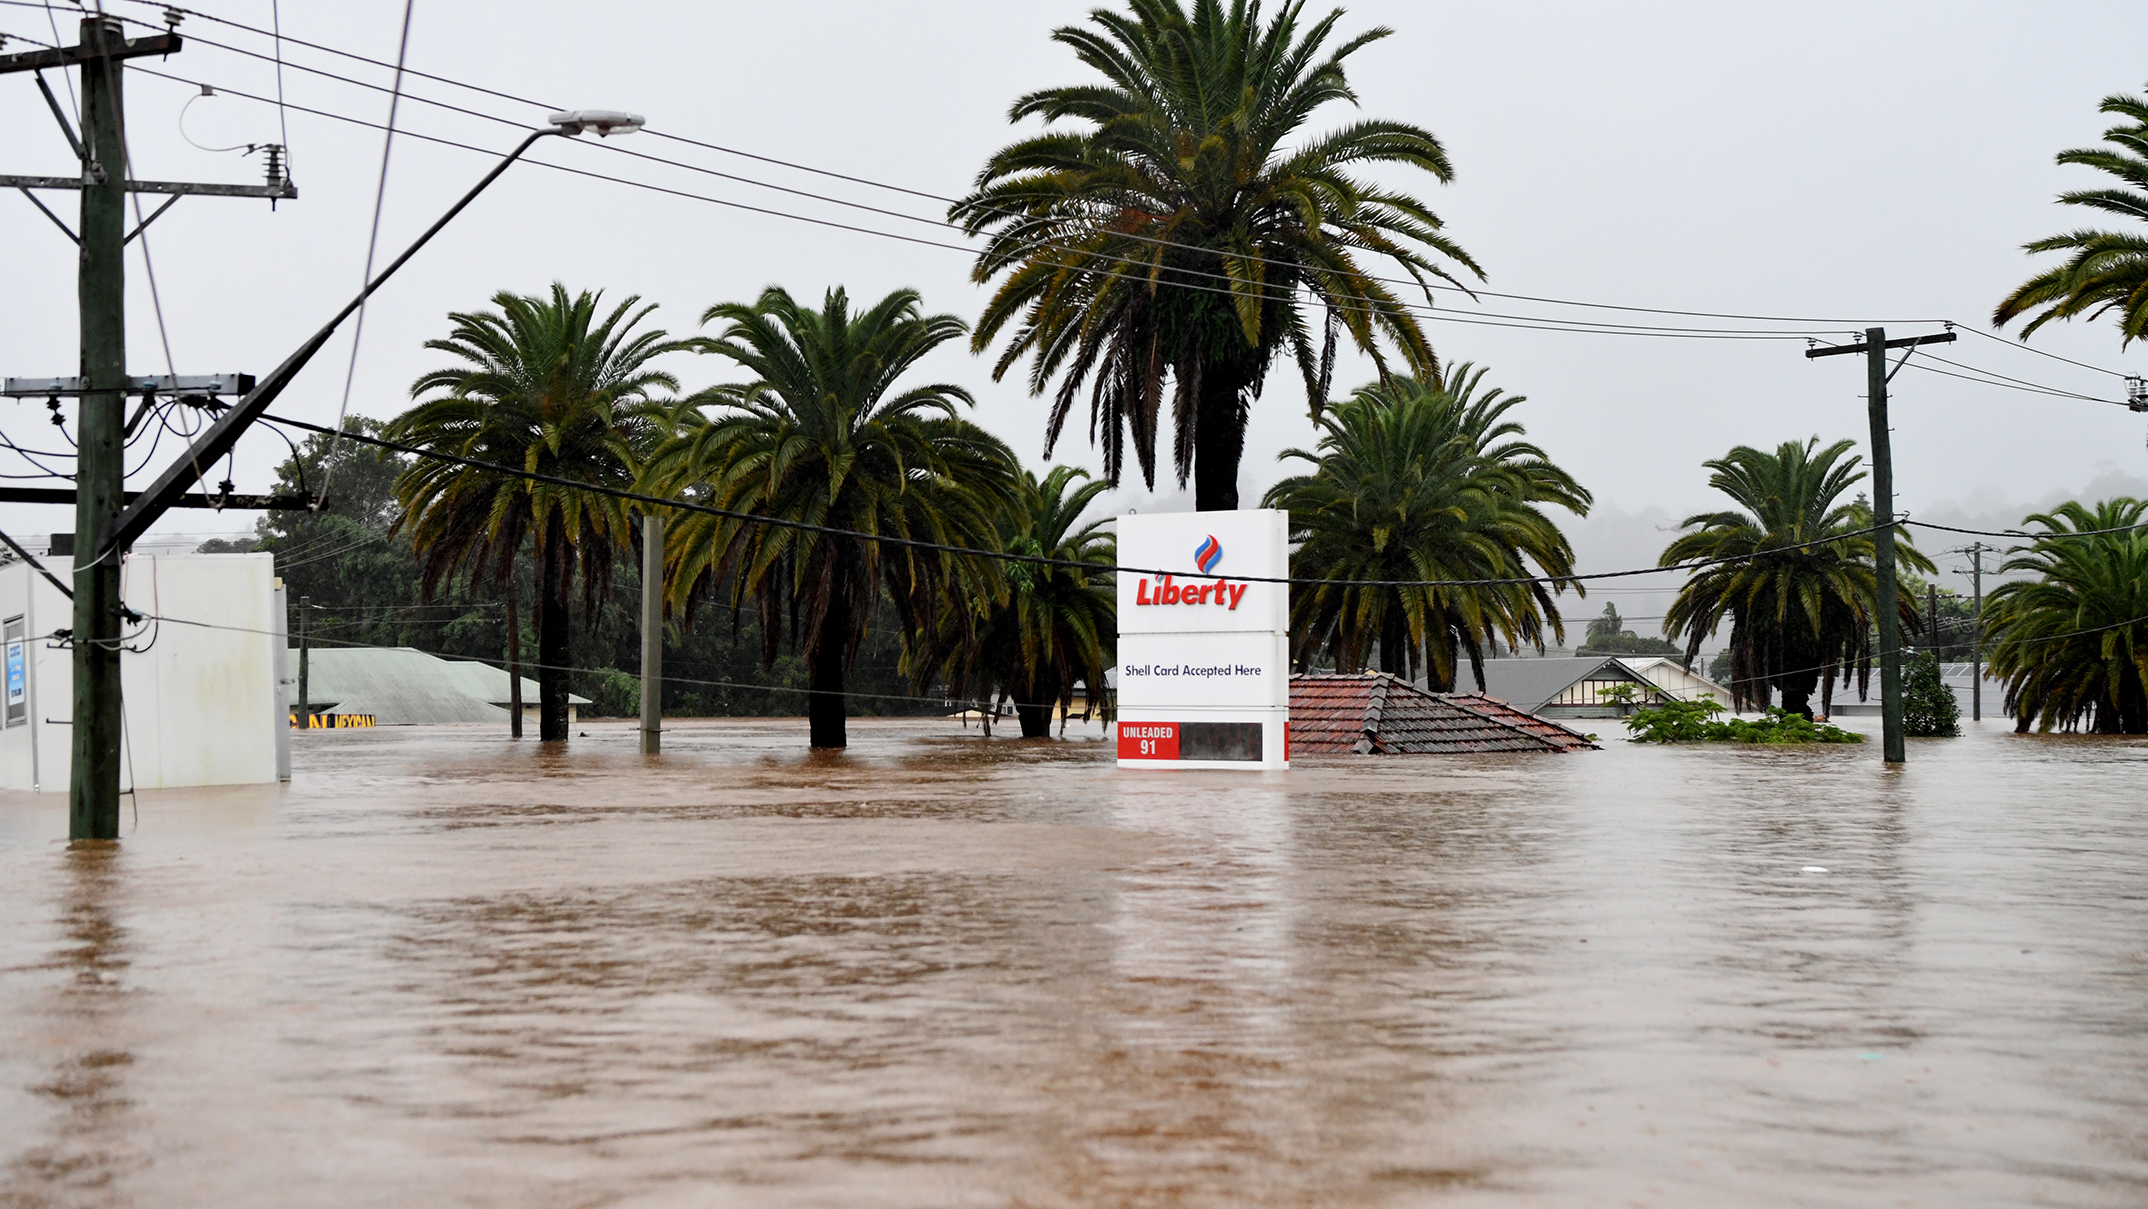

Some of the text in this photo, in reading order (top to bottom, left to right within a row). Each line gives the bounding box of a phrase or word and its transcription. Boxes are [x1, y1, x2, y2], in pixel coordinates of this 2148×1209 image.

[1136, 574, 1247, 610] Liberty
[1125, 664, 1261, 678] Shell Card Accepted Here
[335, 714, 375, 728] MEXICAN
[1123, 727, 1173, 738] UNLEADED
[1140, 739, 1156, 755] 91
